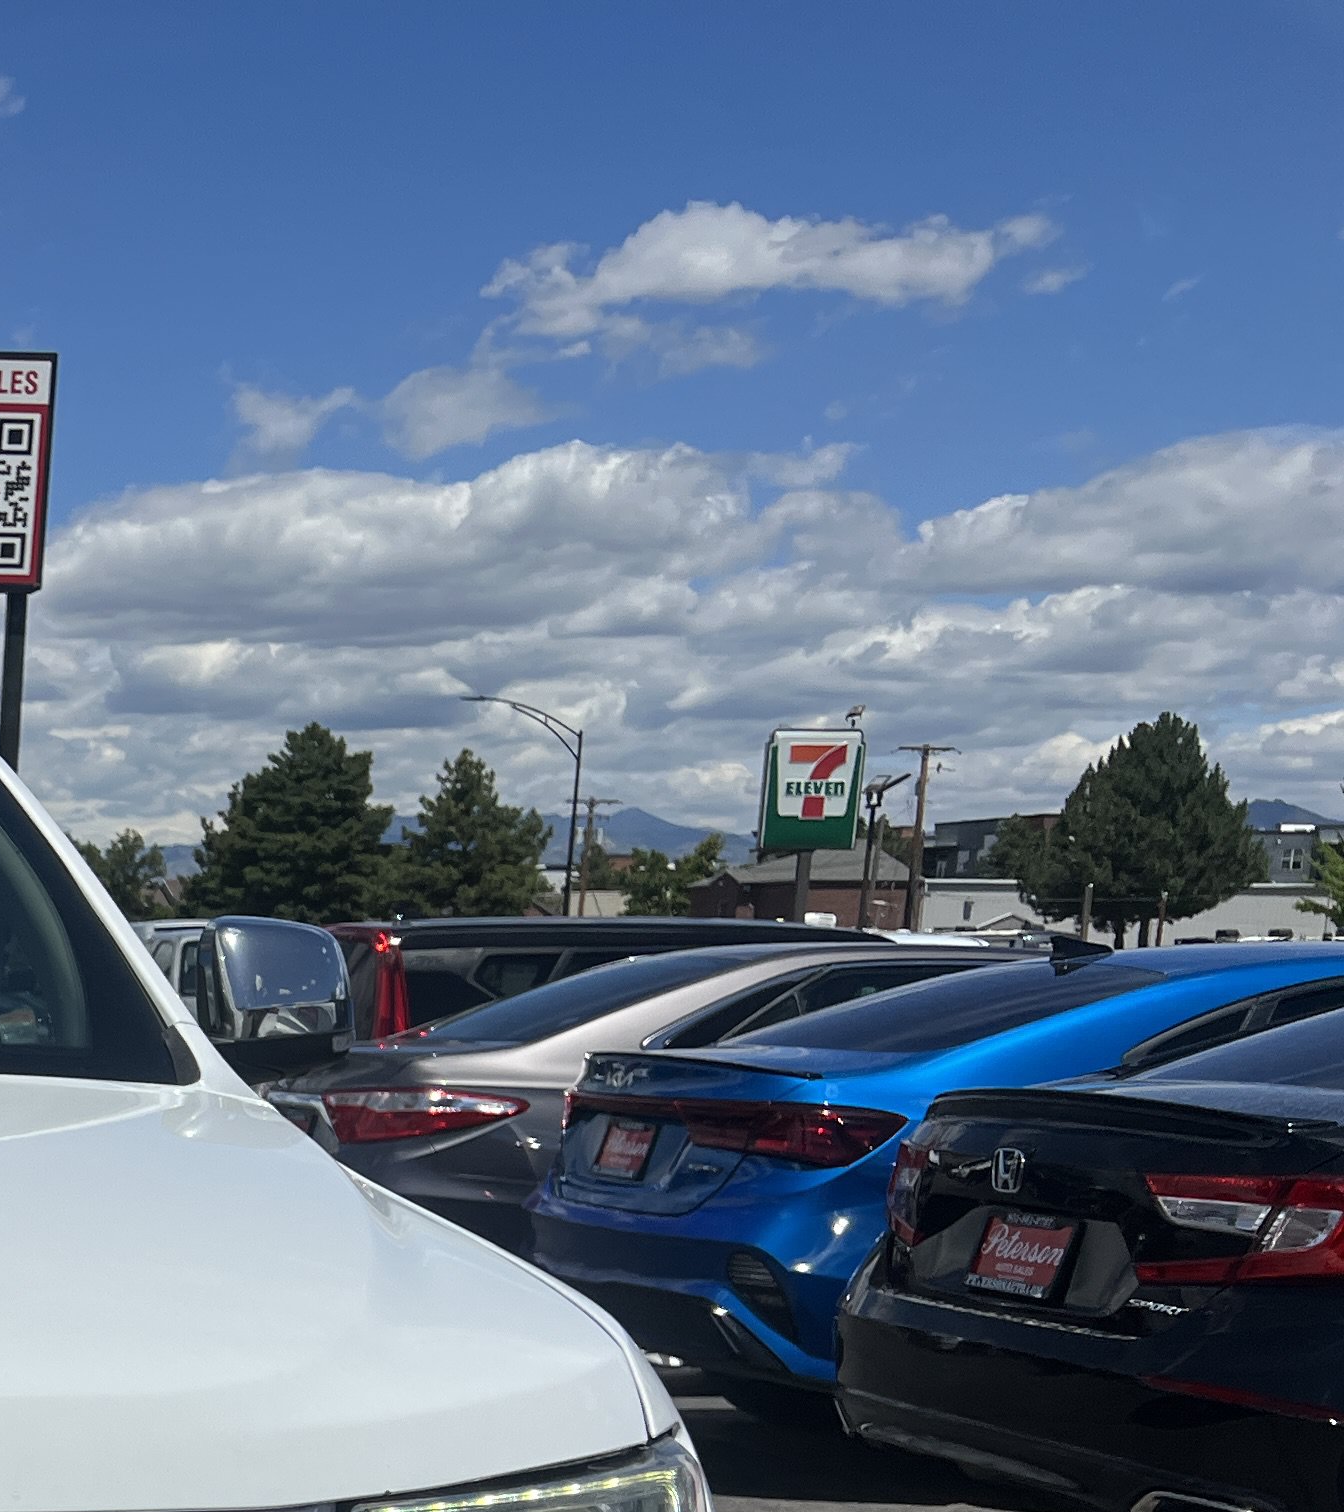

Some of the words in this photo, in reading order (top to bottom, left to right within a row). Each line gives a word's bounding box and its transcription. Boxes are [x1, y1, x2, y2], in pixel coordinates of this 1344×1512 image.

[789, 743, 849, 819] 7
[980, 1223, 1065, 1267] Peterson
[1127, 1298, 1190, 1316] SPORT
